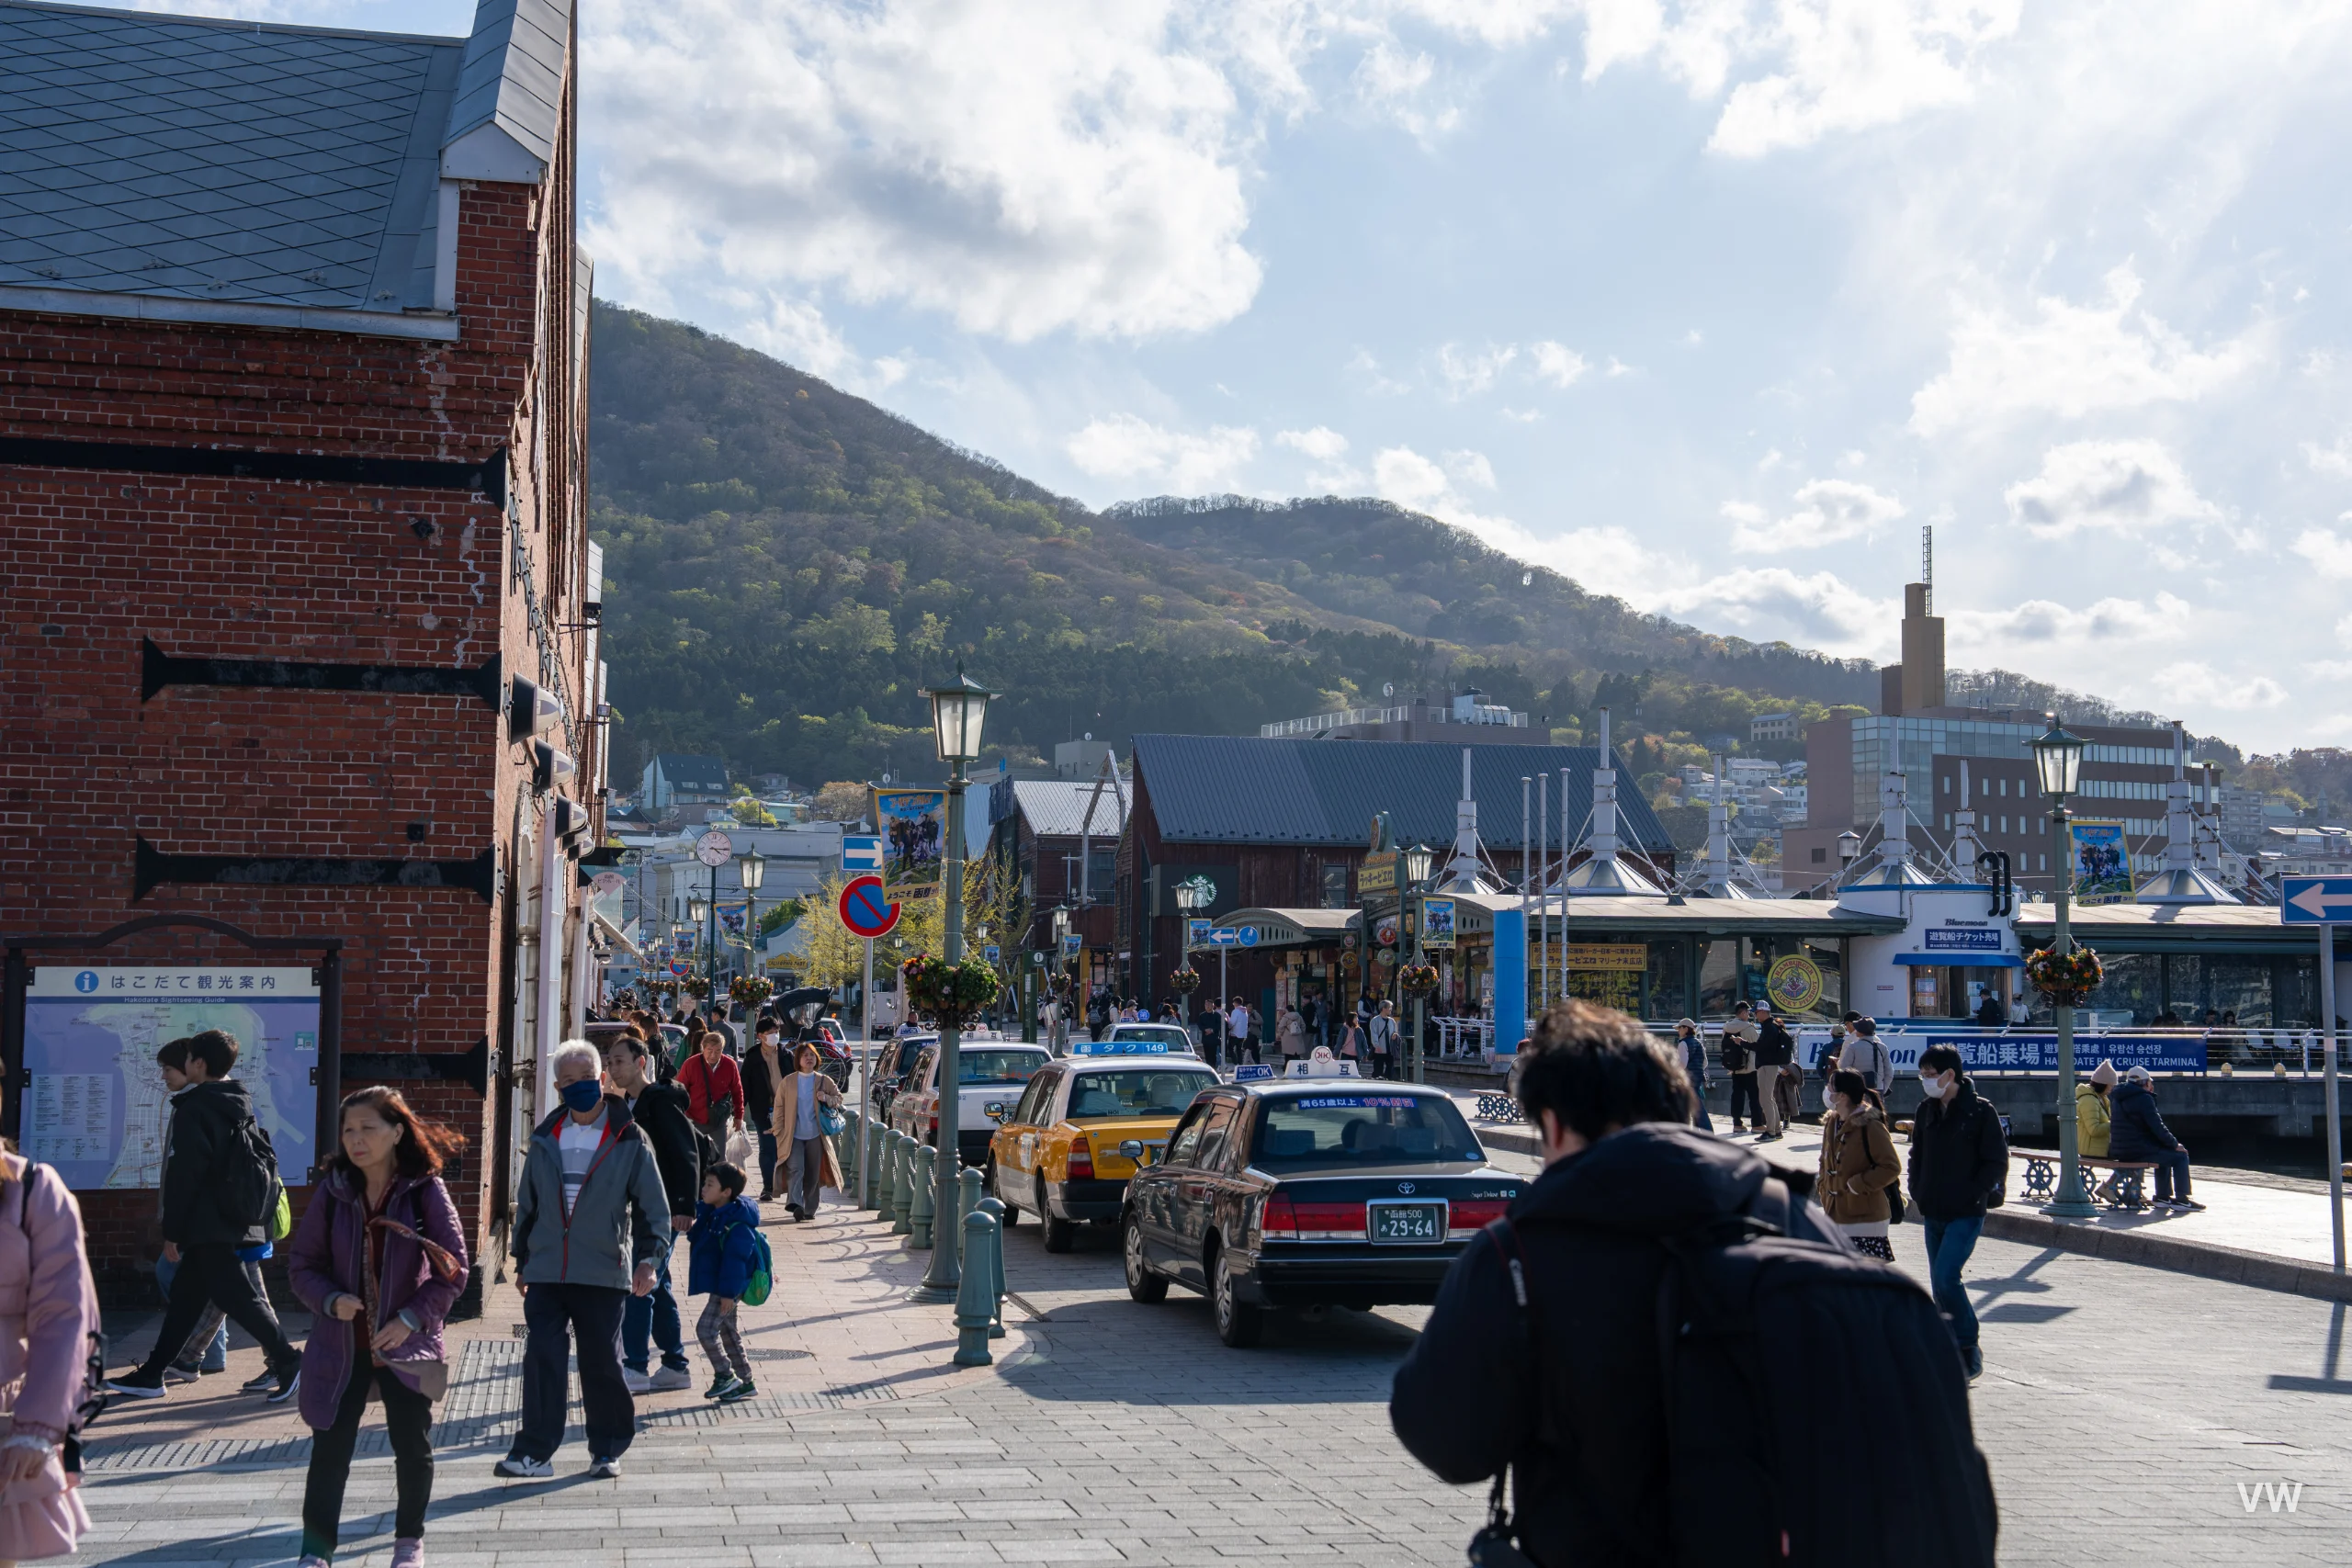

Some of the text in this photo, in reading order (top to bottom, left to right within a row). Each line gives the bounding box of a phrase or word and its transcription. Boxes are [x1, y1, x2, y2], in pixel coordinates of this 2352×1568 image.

[1945, 919, 1988, 927] Bluemoon
[1929, 931, 1998, 942] 遊覧船チケット売場
[1548, 956, 1597, 964] ラッーピエロ
[1775, 960, 1815, 976] HAMBURGER
[111, 975, 276, 989] はこだて観光案内
[1776, 981, 1817, 1006] LUCKY PIERROT
[1145, 1043, 1164, 1053] 149
[2109, 1043, 2134, 1055] 유람선
[2136, 1043, 2162, 1055] 승선장
[1957, 1043, 2041, 1066] 覧船乗場
[2116, 1057, 2150, 1066] CRUISE
[2154, 1057, 2199, 1066] TARMINAL
[1257, 1066, 1270, 1077] OK
[1301, 1098, 1415, 1108] 満65歳以上 10%割引
[1389, 1220, 1433, 1236] 29-64
